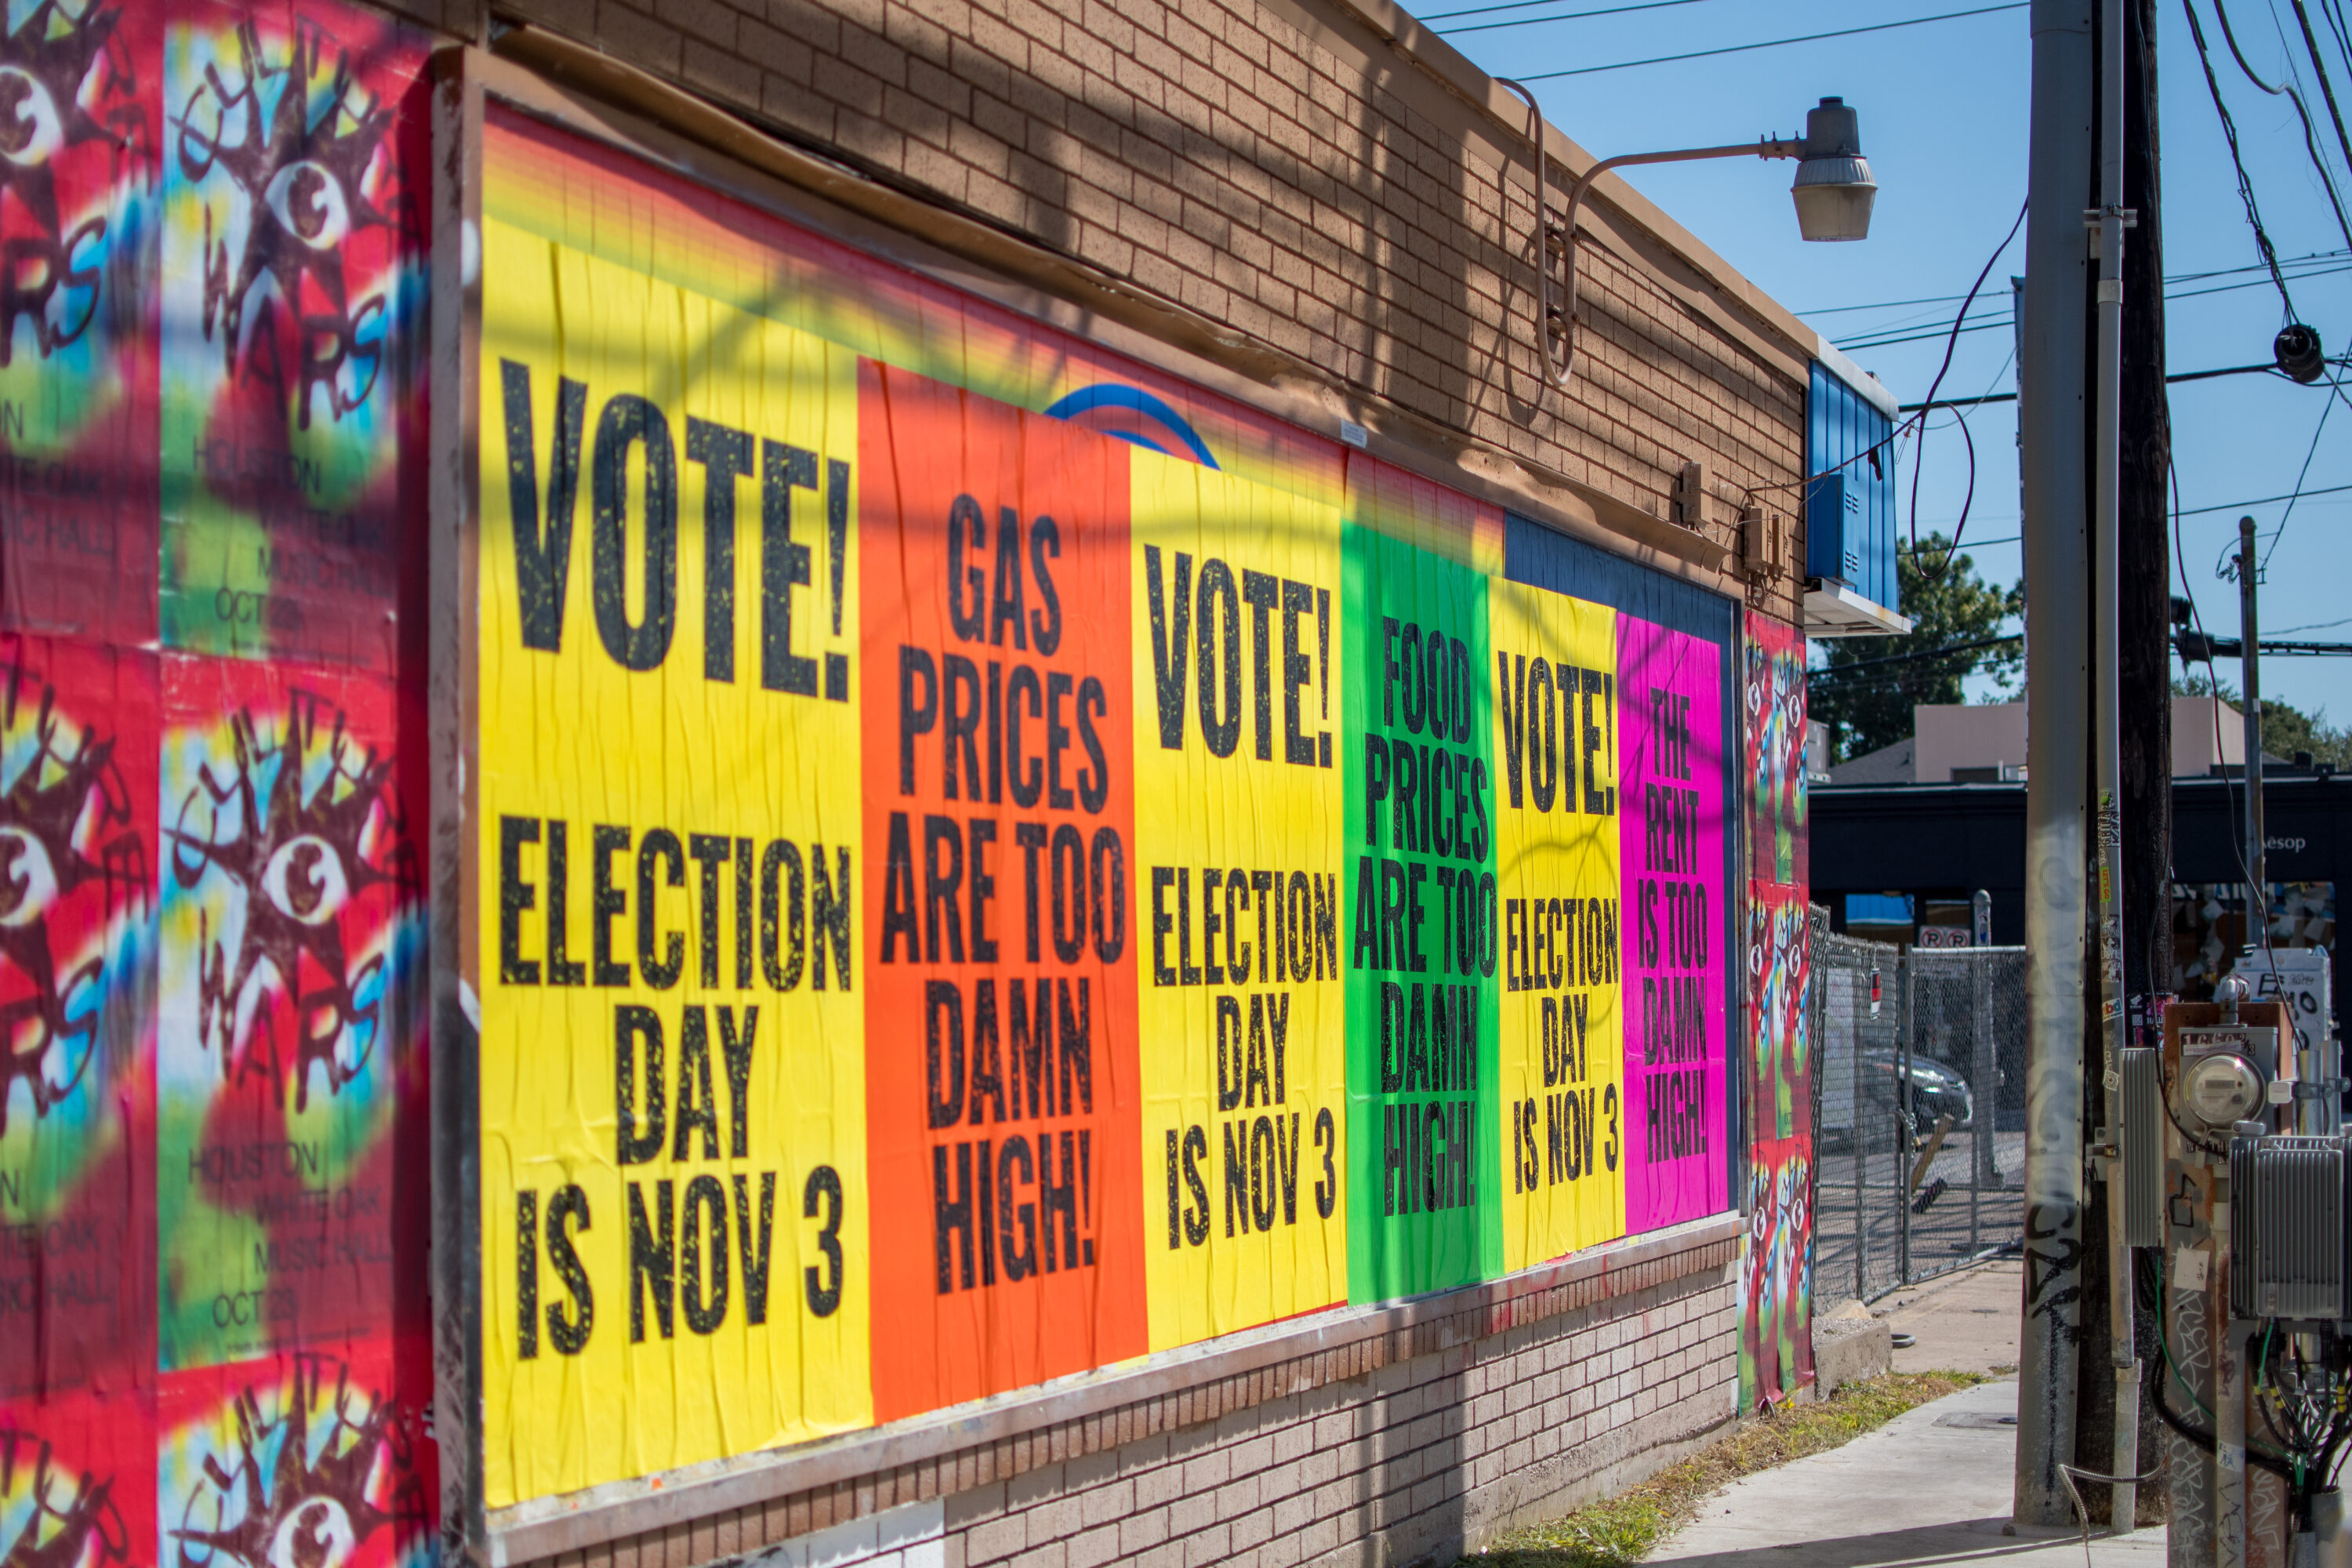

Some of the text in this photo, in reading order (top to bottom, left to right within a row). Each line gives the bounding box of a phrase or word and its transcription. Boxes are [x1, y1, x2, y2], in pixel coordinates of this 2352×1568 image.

[499, 357, 851, 702] VOTE!
[947, 492, 1062, 657] GAS
[215, 586, 266, 624] OCT
[1144, 543, 1333, 768] VOTE!
[898, 644, 1108, 815] PRICES
[1382, 615, 1471, 744] FOOD
[1497, 651, 1615, 816] VOTE!
[1650, 688, 1691, 781] THE
[1365, 733, 1490, 862] PRICES
[1645, 782, 1699, 875] RENT
[499, 815, 851, 992] ELECTION
[880, 811, 1126, 964] ARE TOO
[1151, 866, 1338, 987] ELECTION
[1353, 856, 1497, 978] ARE TOO
[1506, 898, 1618, 993] ELECTION
[1638, 878, 1658, 970] IS
[1665, 882, 1708, 970] TOO
[926, 977, 1093, 1130] DAMN
[1215, 993, 1290, 1112] DAY
[1381, 981, 1477, 1093] DAMN
[1542, 993, 1588, 1087] DAY
[1643, 977, 1706, 1066] DAMN
[615, 1004, 759, 1166] DAY
[1514, 1083, 1618, 1194] IS NOV 3
[1647, 1069, 1706, 1163] HIGH!
[189, 1141, 318, 1184] HOUSTON
[933, 1130, 1095, 1295] HIGH!
[1165, 1107, 1336, 1250] IS NOV 3
[1384, 1101, 1476, 1217] HIGH!
[212, 1292, 263, 1329] OCT
[517, 1166, 844, 1361] IS NOV 3
